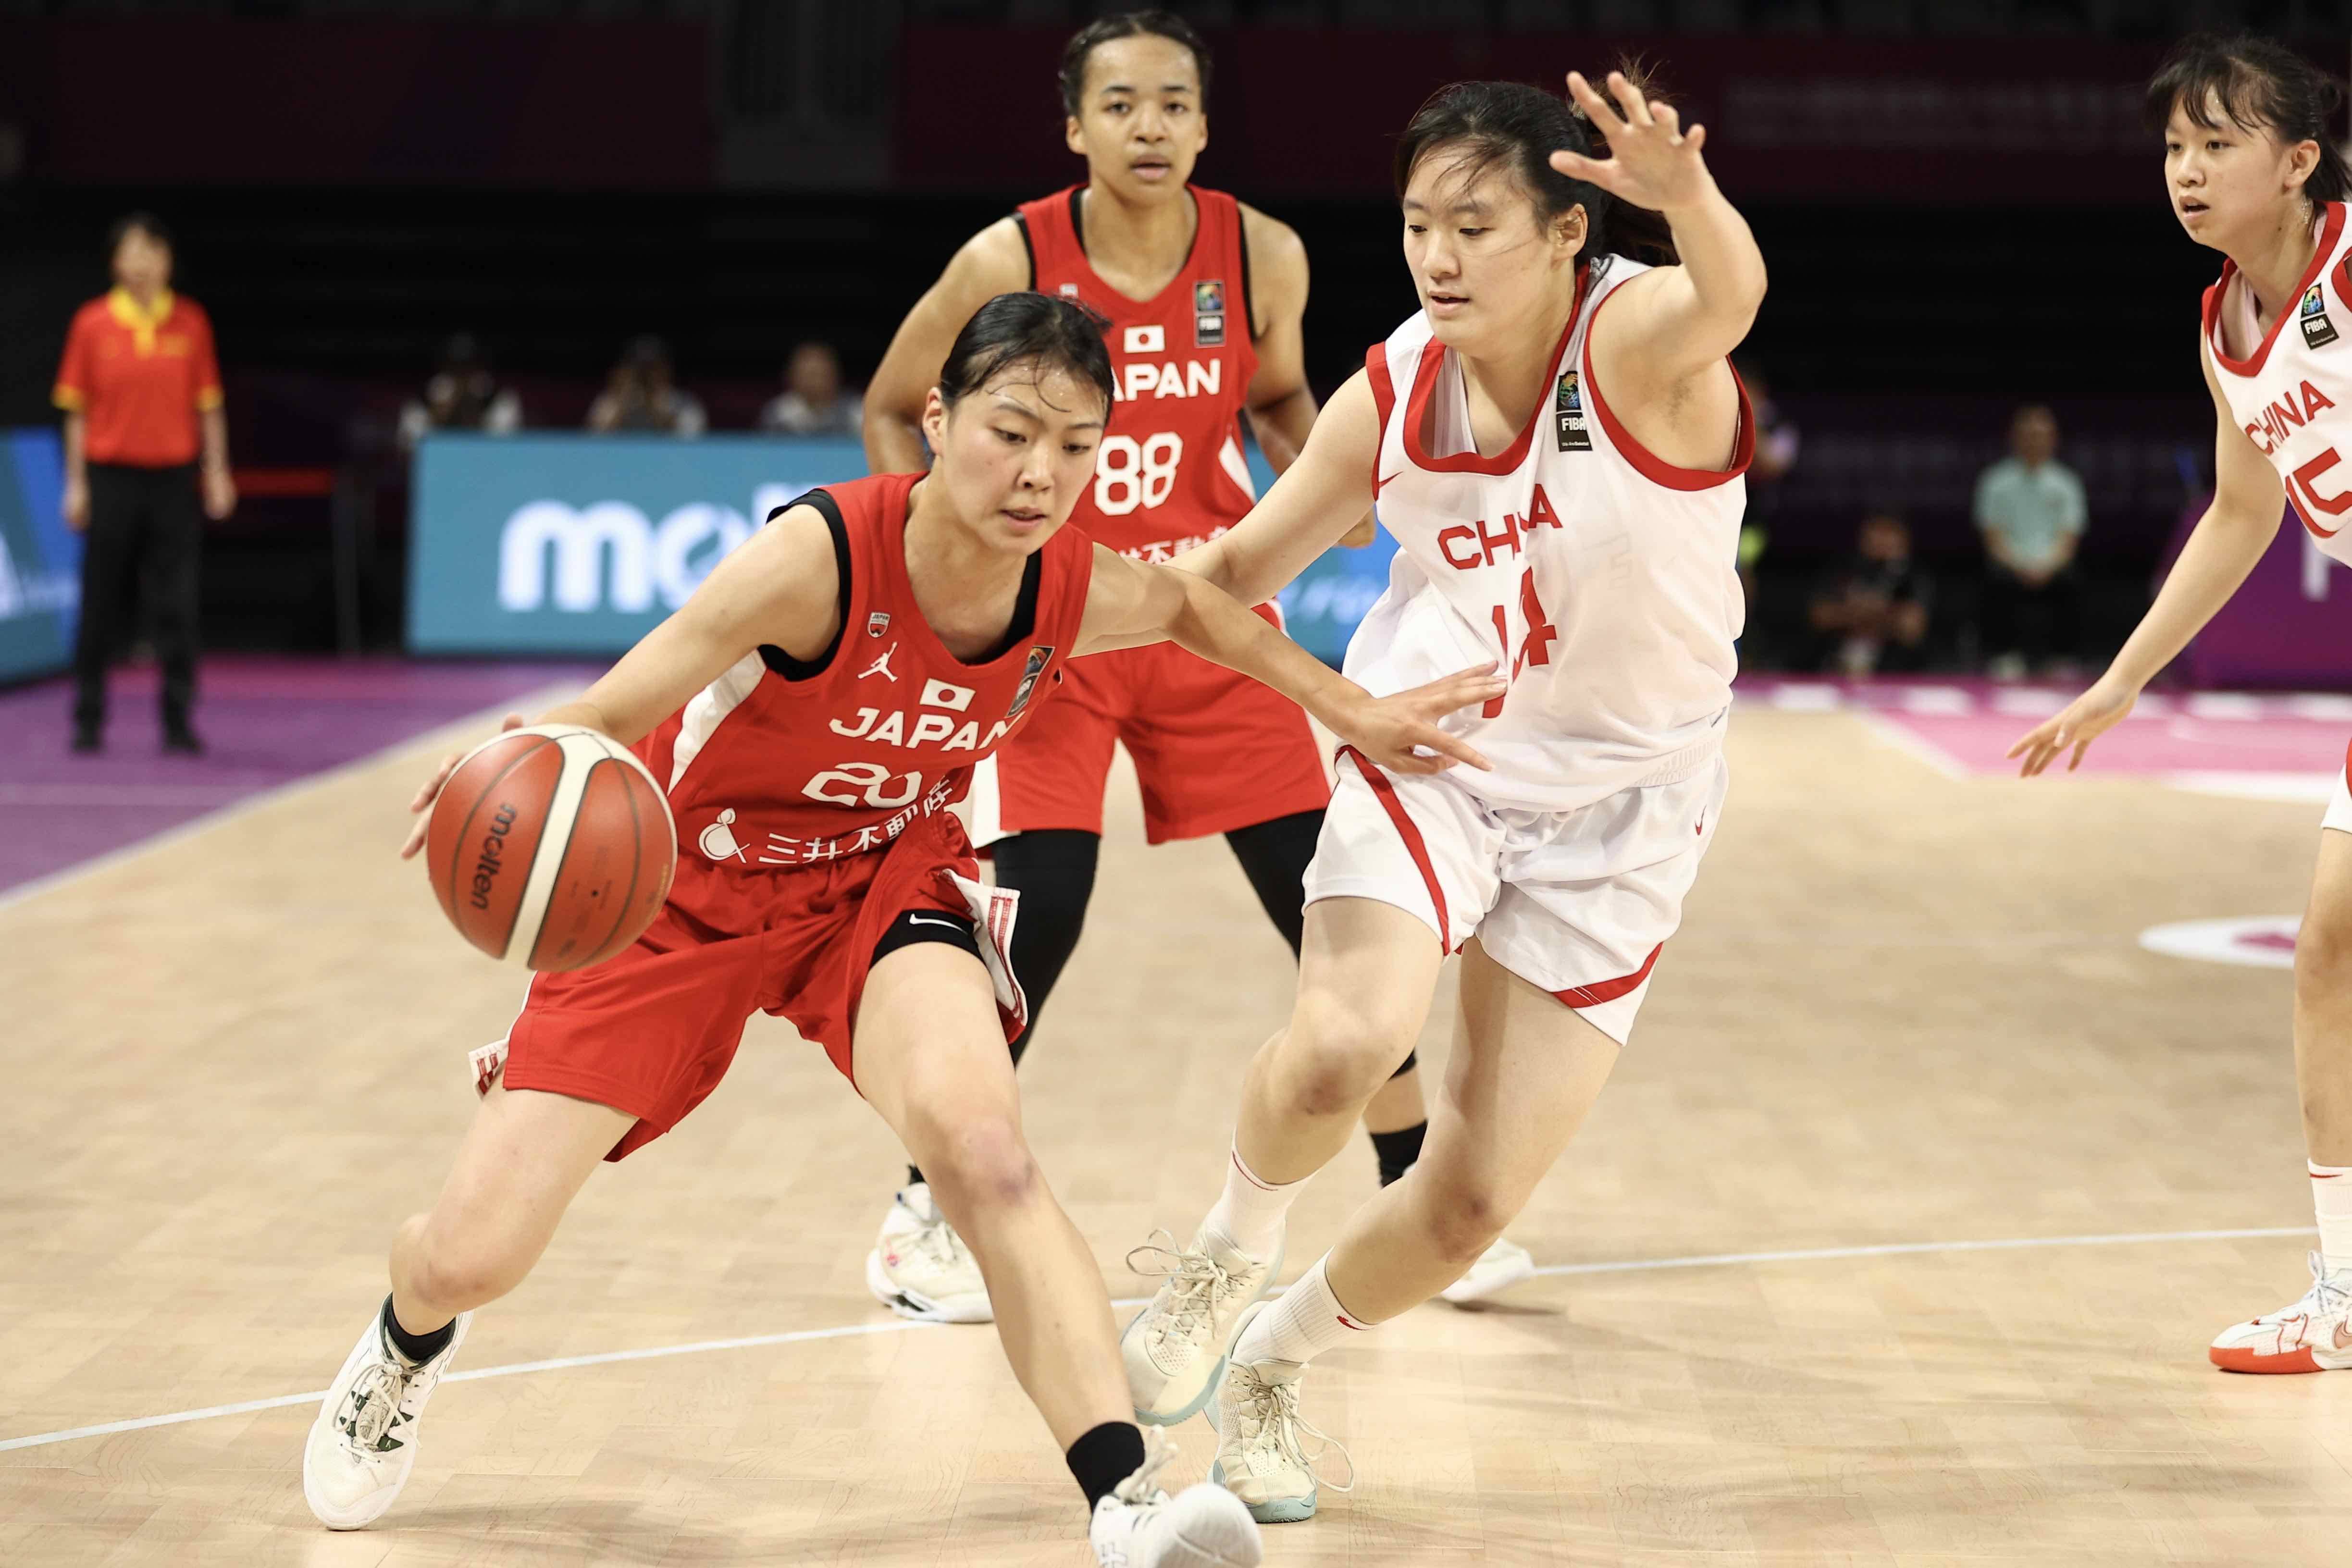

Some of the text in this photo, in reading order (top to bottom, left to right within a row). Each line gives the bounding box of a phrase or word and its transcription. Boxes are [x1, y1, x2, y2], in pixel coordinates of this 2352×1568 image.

[2304, 318, 2327, 334] FIBA
[1561, 417, 1586, 431] FIBA
[2245, 380, 2336, 456] CHINA
[1094, 432, 1184, 516] 88
[829, 710, 1026, 752] JAPAN
[801, 762, 923, 809] 20
[470, 803, 517, 909] molten
